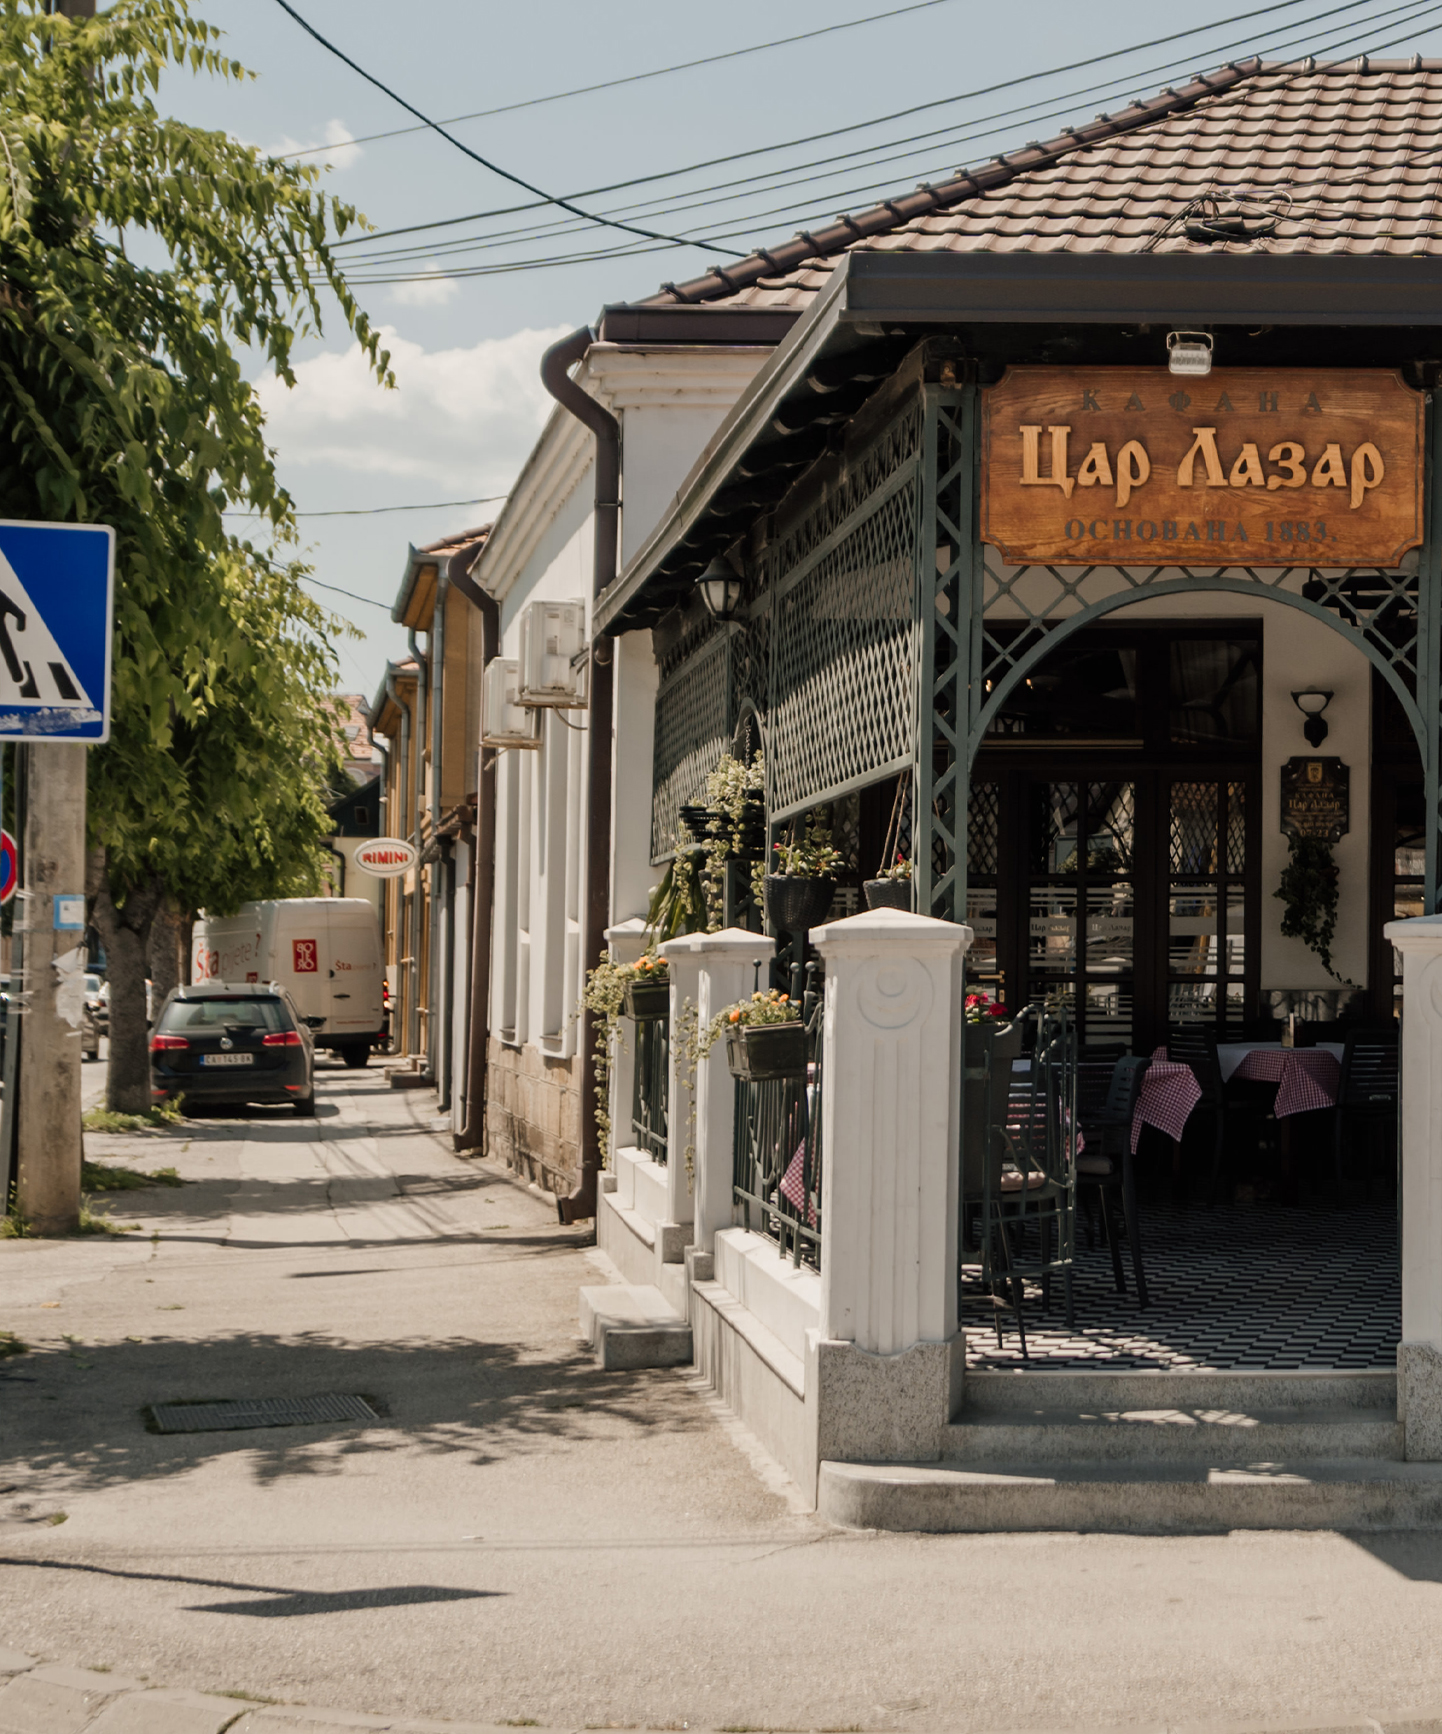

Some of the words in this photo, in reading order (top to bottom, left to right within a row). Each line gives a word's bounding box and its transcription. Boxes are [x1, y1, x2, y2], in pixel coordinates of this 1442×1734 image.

[1081, 388, 1324, 413] КАФАНА
[1017, 424, 1152, 509] Цар
[1176, 426, 1387, 510] Лазар
[1063, 518, 1250, 543] ОСНОВАНА
[1264, 519, 1339, 543] 1883.
[362, 851, 409, 865] RIMINI
[195, 942, 219, 983] Šta
[335, 959, 352, 971] Šta
